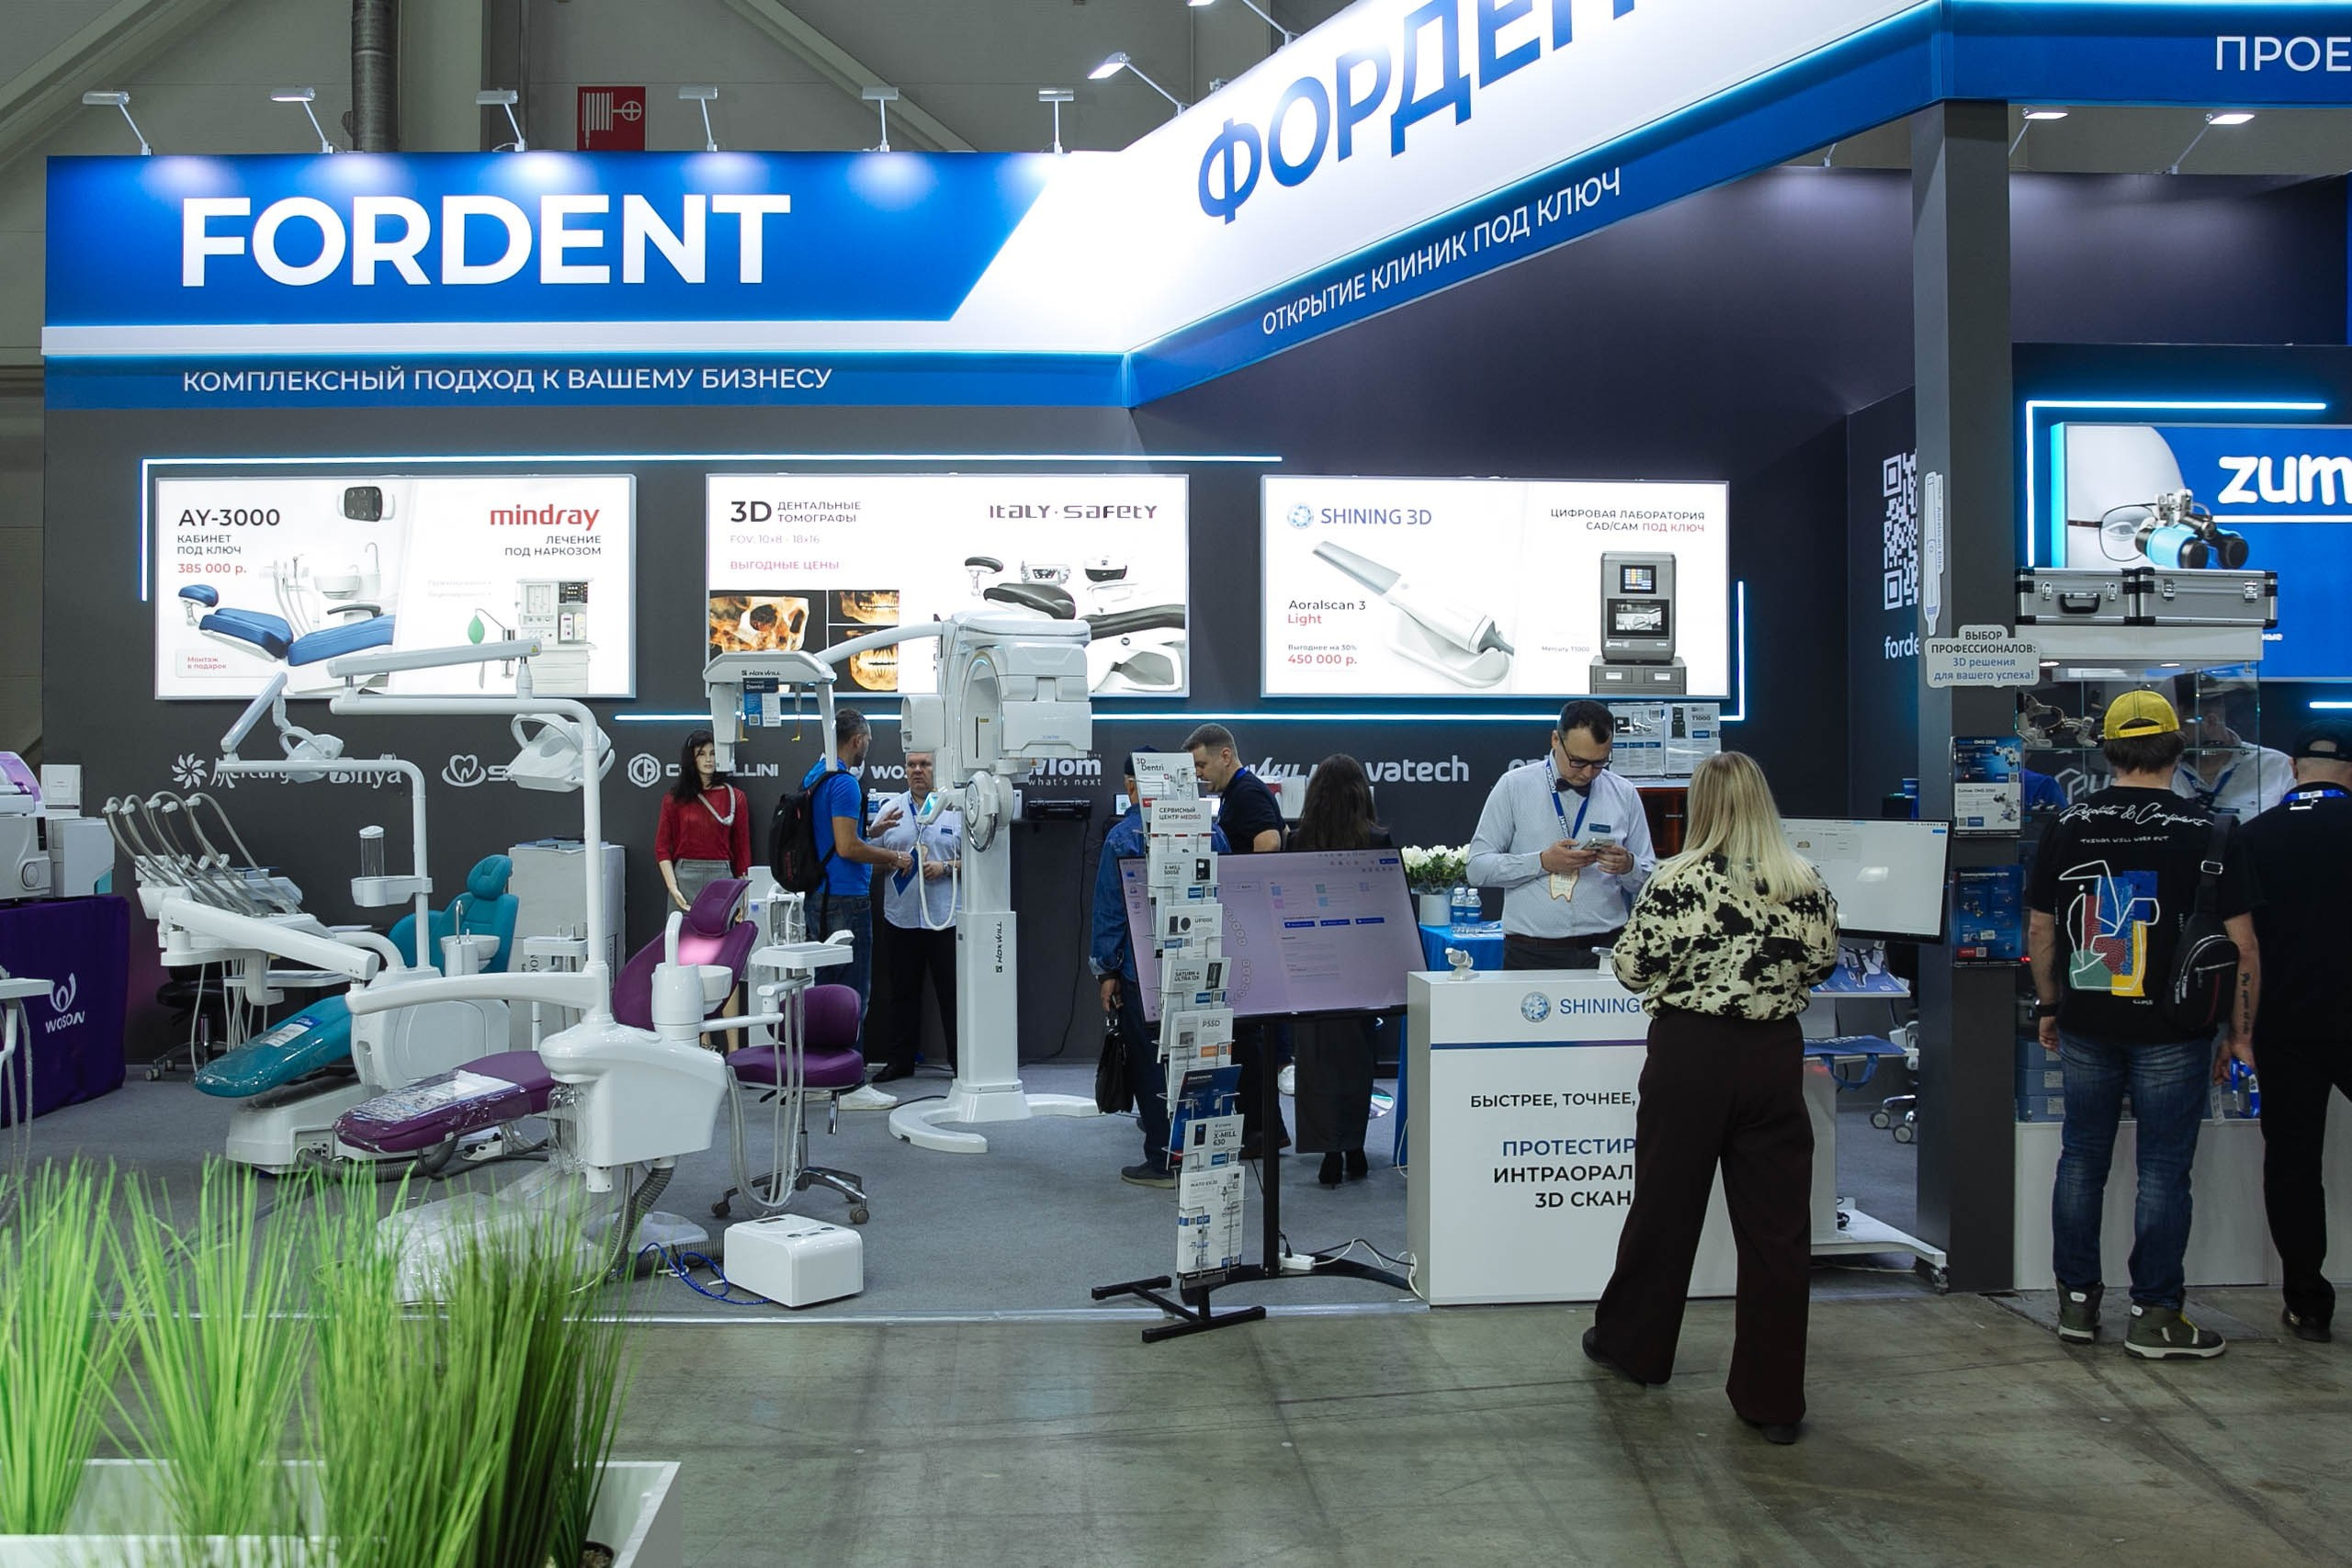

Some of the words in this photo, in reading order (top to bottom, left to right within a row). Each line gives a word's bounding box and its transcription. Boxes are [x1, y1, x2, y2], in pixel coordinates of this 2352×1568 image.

[2216, 36, 2352, 72] ПРОЕ
[183, 194, 791, 287] FORDENT
[1262, 273, 1366, 335] ОТКРЫТИЕ
[1371, 231, 1468, 294] КЛИНИК
[1473, 206, 1531, 253] ПОД
[1536, 167, 1621, 227] КЛЮЧ
[184, 365, 406, 392] КОМПЛЕКСНЫЙ
[414, 368, 535, 393] ПОДХОД
[542, 368, 560, 389] К
[571, 367, 695, 389] ВАШЕМУ
[702, 367, 832, 389] БИЗНЕСУ
[730, 501, 773, 523] 3D
[777, 502, 862, 511] ДЕНТАЛЬНЫЕ
[178, 509, 280, 526] AY-3000
[490, 504, 600, 531] mindray
[778, 514, 856, 523] ТОМОГРАФЫ
[1320, 508, 1402, 525] SHINING
[1407, 509, 1432, 525] 3D
[1551, 509, 1616, 519] ЦИФРОВАЯ
[1620, 511, 1705, 521] ЛАБОРАТОРИЯ
[1586, 522, 1638, 532] CAD/CAM
[1643, 523, 1668, 533] ПОД
[1670, 524, 1705, 533] КЛЮЧ
[177, 535, 232, 544] КАБИНЕТ
[546, 536, 602, 545] ЛЕЧЕНИЕ
[177, 547, 203, 556] ПОД
[207, 546, 242, 555] КЛЮЧ
[505, 547, 531, 557] ПОД
[534, 547, 602, 556] НАРКОЗОМ
[177, 564, 202, 573] 385
[205, 563, 231, 573] 000
[235, 565, 247, 575] р.
[730, 561, 799, 570] ВЫГОДНЫЕ
[804, 560, 840, 570] ЦЕНЫ
[1289, 600, 1354, 611] Aoralscan
[1359, 601, 1366, 611] 3
[1288, 614, 1322, 626] Light
[1965, 631, 2003, 640] ВЫБОР
[1931, 644, 2036, 654] ПРОФЕССИОНАЛОВ:
[1288, 654, 1314, 664] 450
[1316, 654, 1341, 664] 000
[1952, 658, 1966, 667] 3D
[1969, 660, 2016, 668] решения
[1956, 671, 1994, 680] вашего
[1996, 671, 2034, 680] успеха!
[1141, 763, 1164, 772] Dentri
[1365, 755, 1470, 782] vatech
[1028, 777, 1068, 786] what's
[1074, 778, 1102, 786] next
[1559, 998, 1640, 1015] SHINING
[46, 1010, 85, 1033] WOSON
[1471, 1094, 1557, 1108] БЫСТРЕЕ,
[1562, 1091, 1636, 1106] ТОЧНЕЕ,
[1502, 1138, 1636, 1157] ПРОТЕСТИР
[1494, 1164, 1634, 1183] ИНТРАОРАЛ
[1535, 1192, 1564, 1208] 3D
[1570, 1190, 1632, 1207] СКАН
